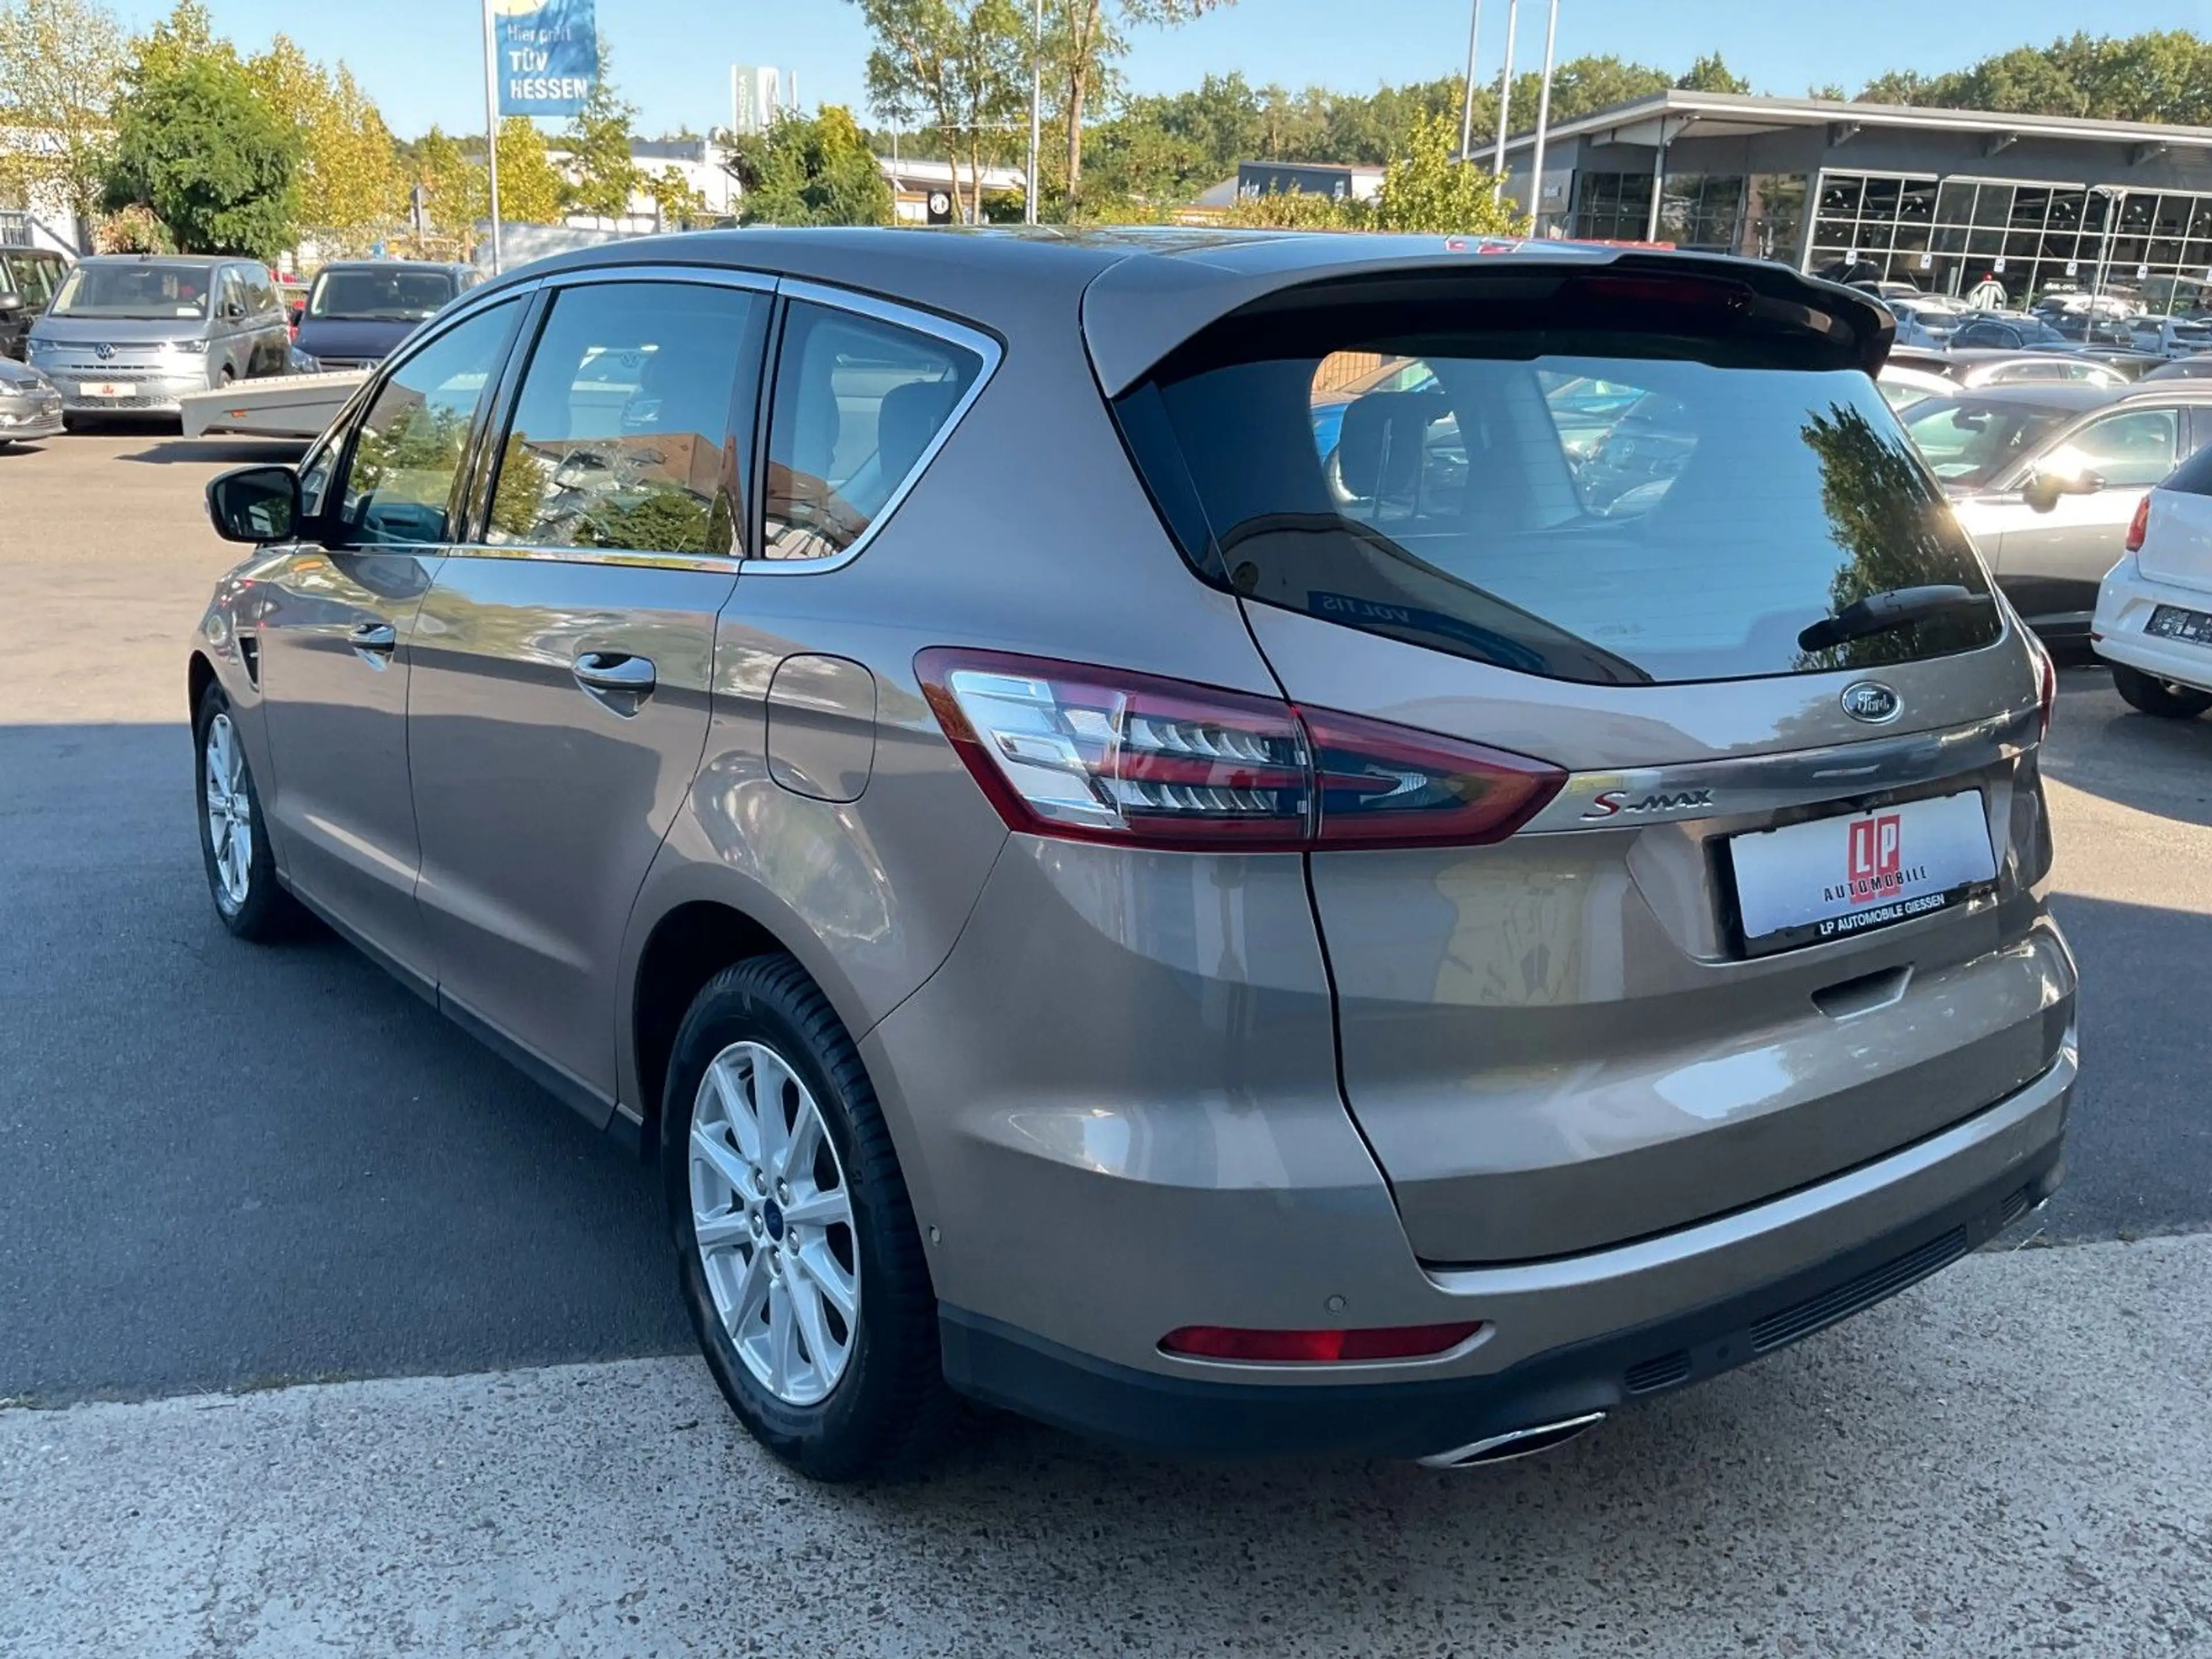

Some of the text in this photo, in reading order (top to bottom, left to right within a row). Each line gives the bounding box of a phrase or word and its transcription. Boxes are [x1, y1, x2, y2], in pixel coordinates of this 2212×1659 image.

[507, 24, 535, 41] Hier
[509, 48, 547, 71] TÜV
[510, 77, 588, 99] HESSEN
[1857, 691, 1889, 713] Ford
[1579, 789, 1714, 821] S-MAX
[1855, 821, 1898, 874] LP
[1823, 865, 1927, 902] AUTOMOBILE
[1819, 893, 1945, 935] LP AUTOMOBILE GIESSEN
